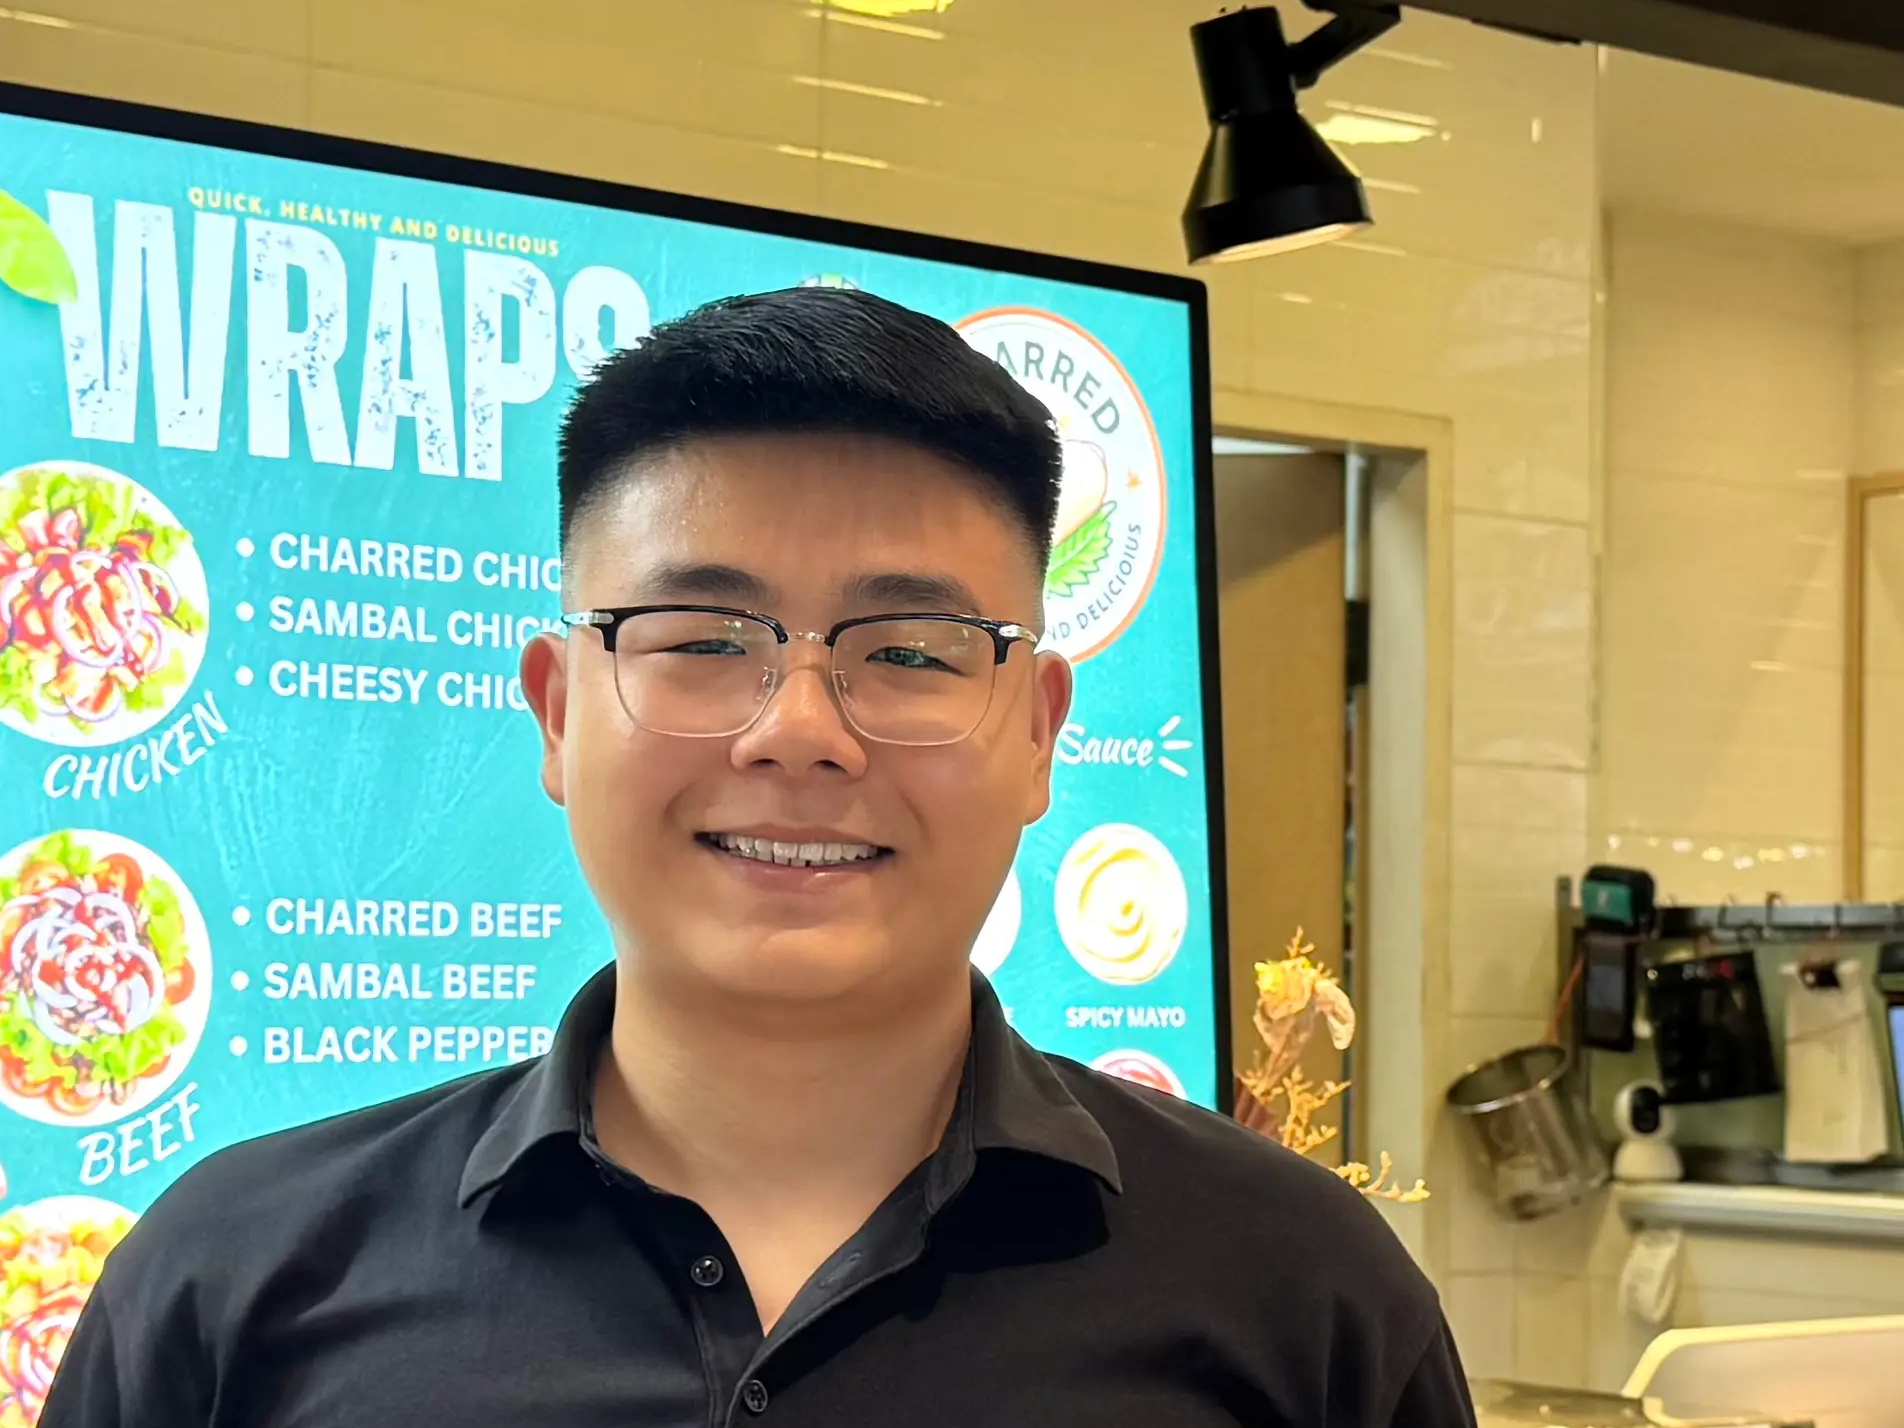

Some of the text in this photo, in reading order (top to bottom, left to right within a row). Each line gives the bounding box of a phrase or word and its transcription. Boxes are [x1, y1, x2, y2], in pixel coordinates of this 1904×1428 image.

[279, 198, 383, 233] HEALTHY
[390, 217, 439, 240] AND
[445, 224, 561, 258] DELICIOUS
[270, 533, 464, 584] CHARRED
[269, 597, 437, 643] SAMBAL
[269, 660, 429, 705] CHEESY
[43, 692, 230, 801] CHICKEN
[1056, 722, 1156, 767] Sauce
[264, 897, 563, 939] CHARRED BEEF
[263, 962, 536, 1001] SAMBAL BEEF
[1064, 1007, 1187, 1029] SPICY MAYO
[264, 1024, 398, 1064] BLACK
[76, 1082, 201, 1186] BEEF
